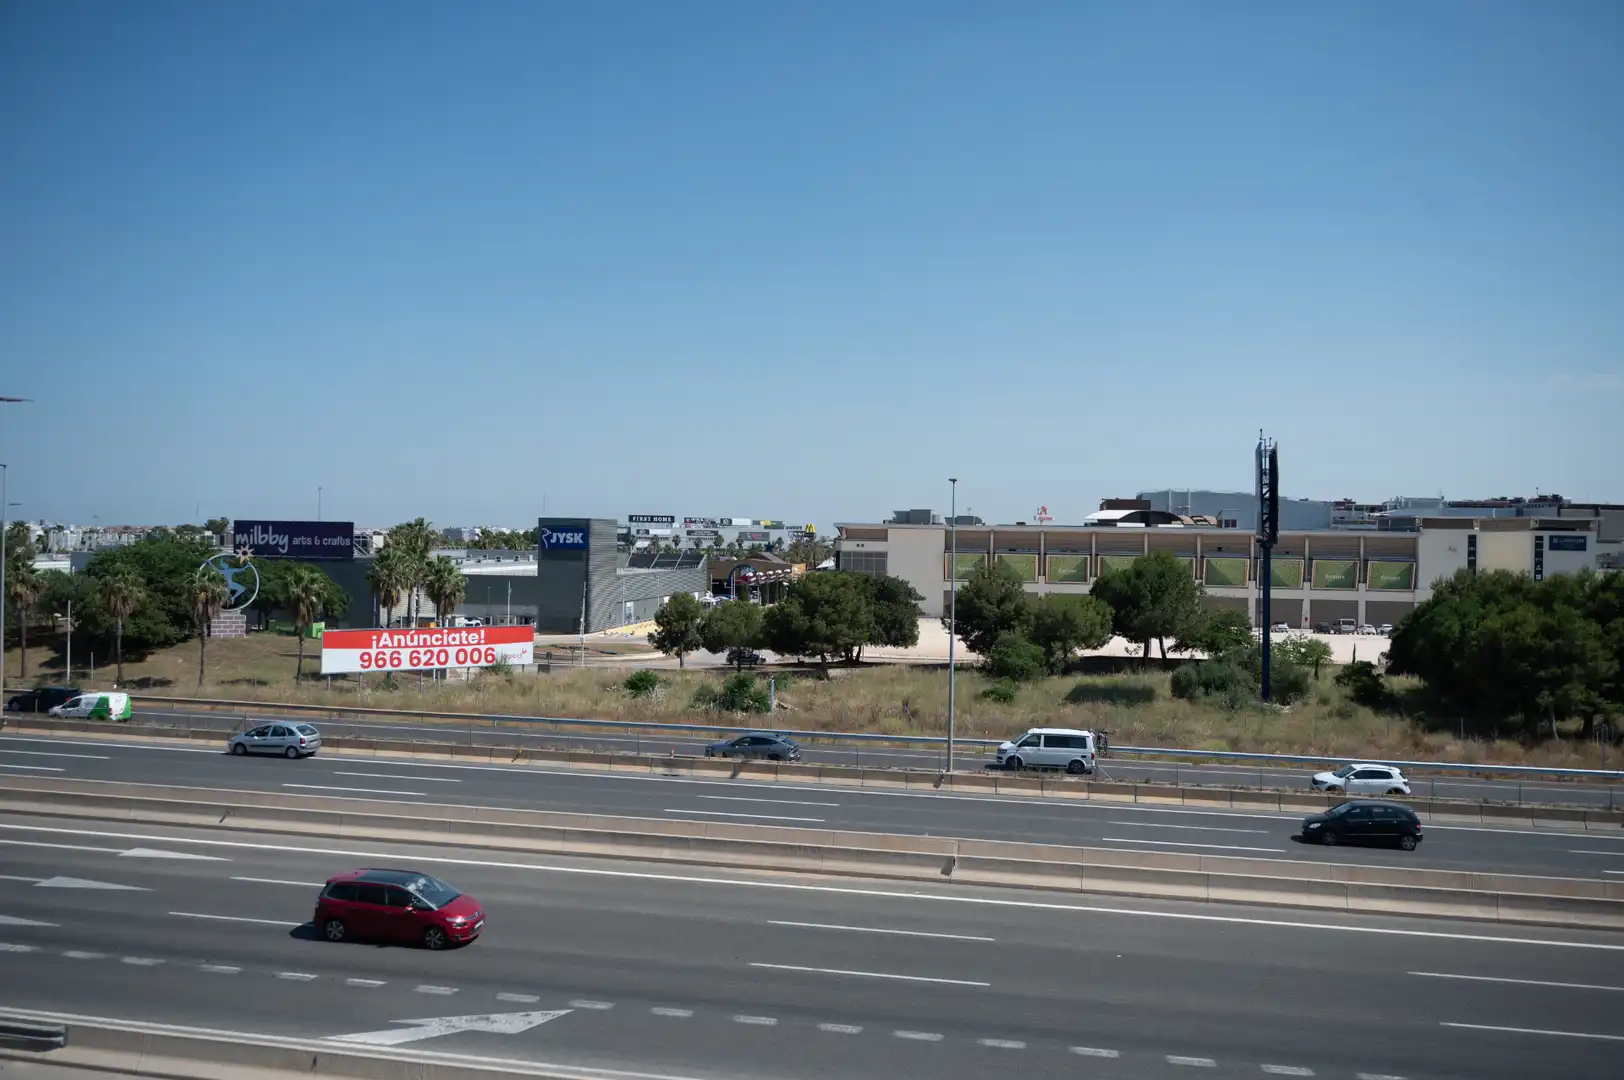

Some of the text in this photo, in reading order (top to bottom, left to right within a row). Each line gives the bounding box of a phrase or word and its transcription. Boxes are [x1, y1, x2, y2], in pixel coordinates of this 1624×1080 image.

[235, 525, 289, 554] milbby
[292, 536, 312, 545] arts
[322, 536, 351, 546] crafts
[550, 532, 584, 544] JYSK
[371, 629, 486, 649] ¡Anúnciate!
[359, 647, 496, 670] 966 620 006
